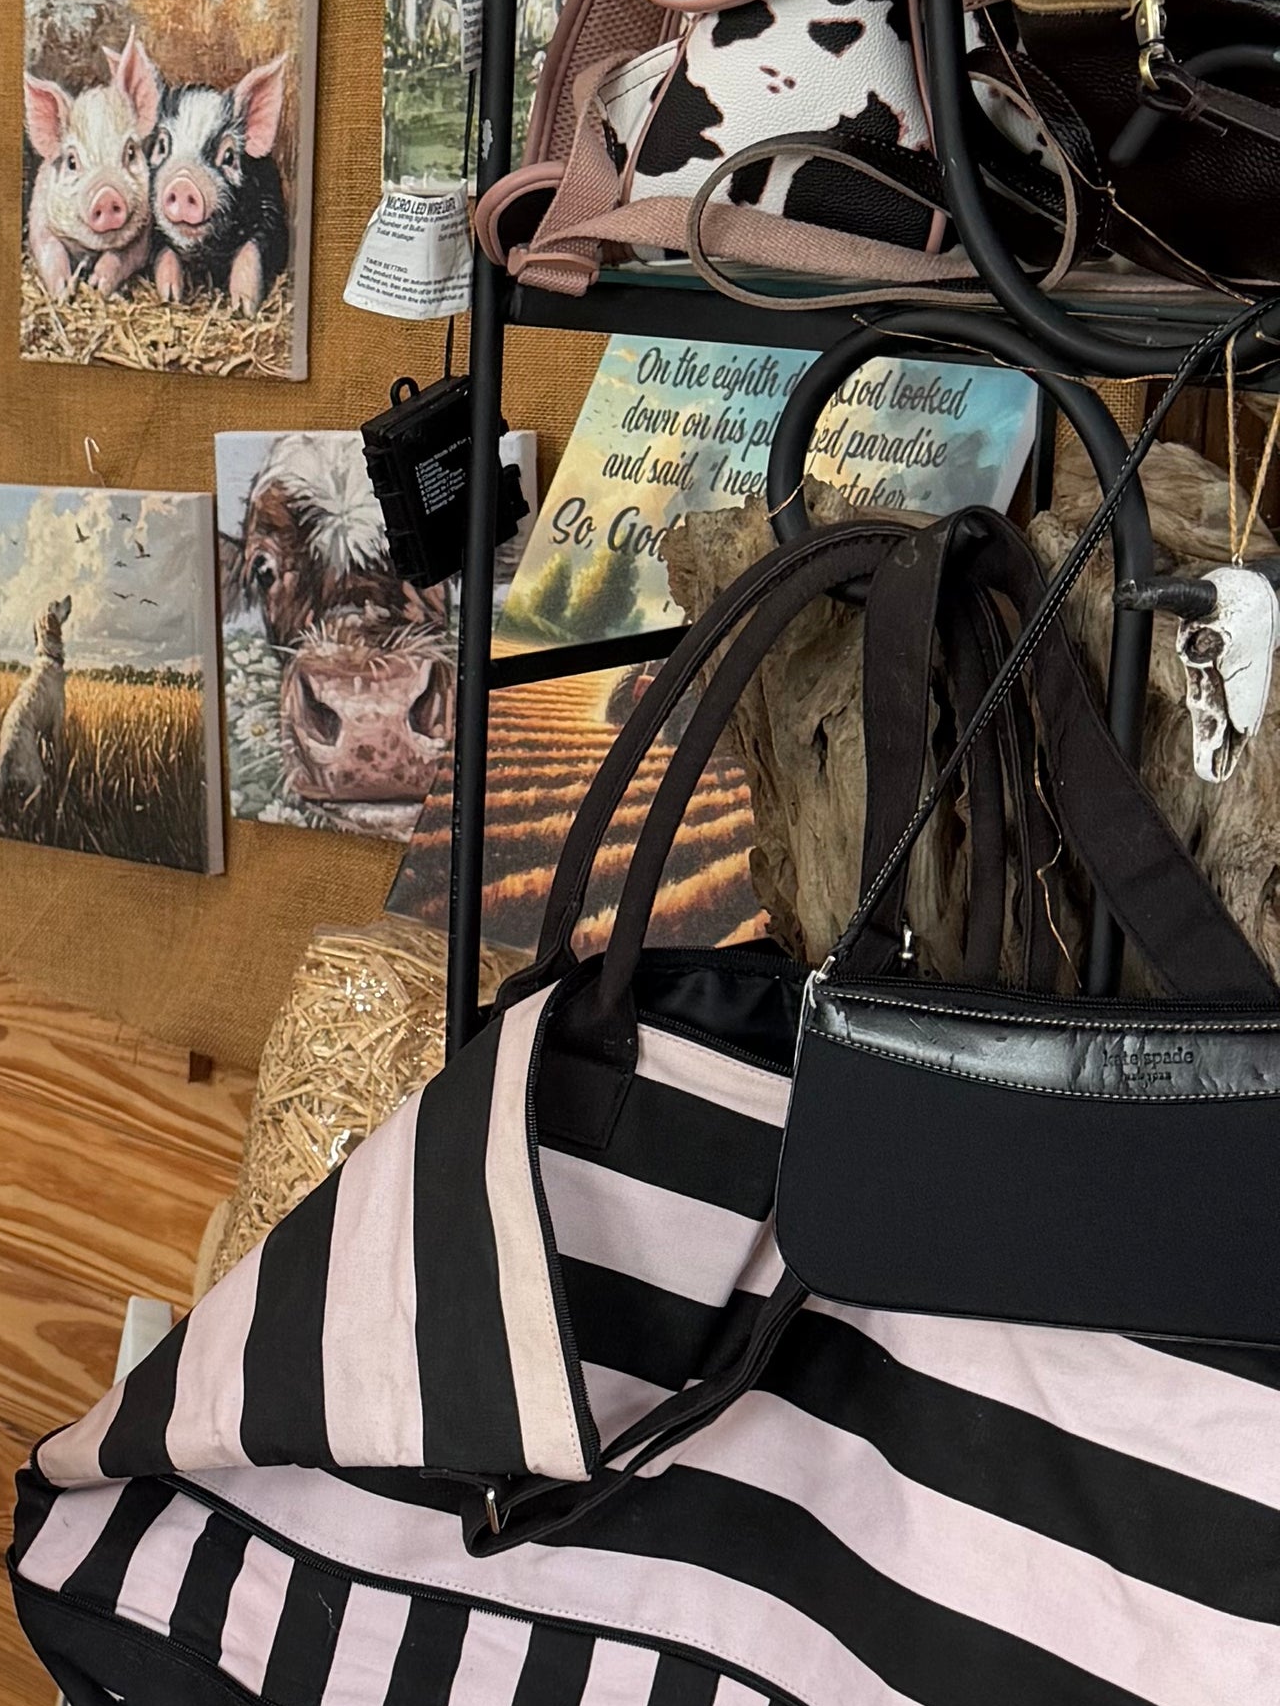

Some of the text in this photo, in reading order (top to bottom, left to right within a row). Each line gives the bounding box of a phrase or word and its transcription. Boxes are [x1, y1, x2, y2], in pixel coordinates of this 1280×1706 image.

[637, 346, 671, 385] On
[672, 346, 710, 389] the
[712, 354, 782, 401] eighth
[889, 371, 973, 421] looked
[602, 446, 650, 485] and
[621, 395, 680, 436] down
[682, 410, 711, 440] on
[712, 405, 748, 446] his
[837, 426, 949, 474] paradise
[552, 497, 683, 562] So, God
[1143, 1045, 1195, 1070] spade
